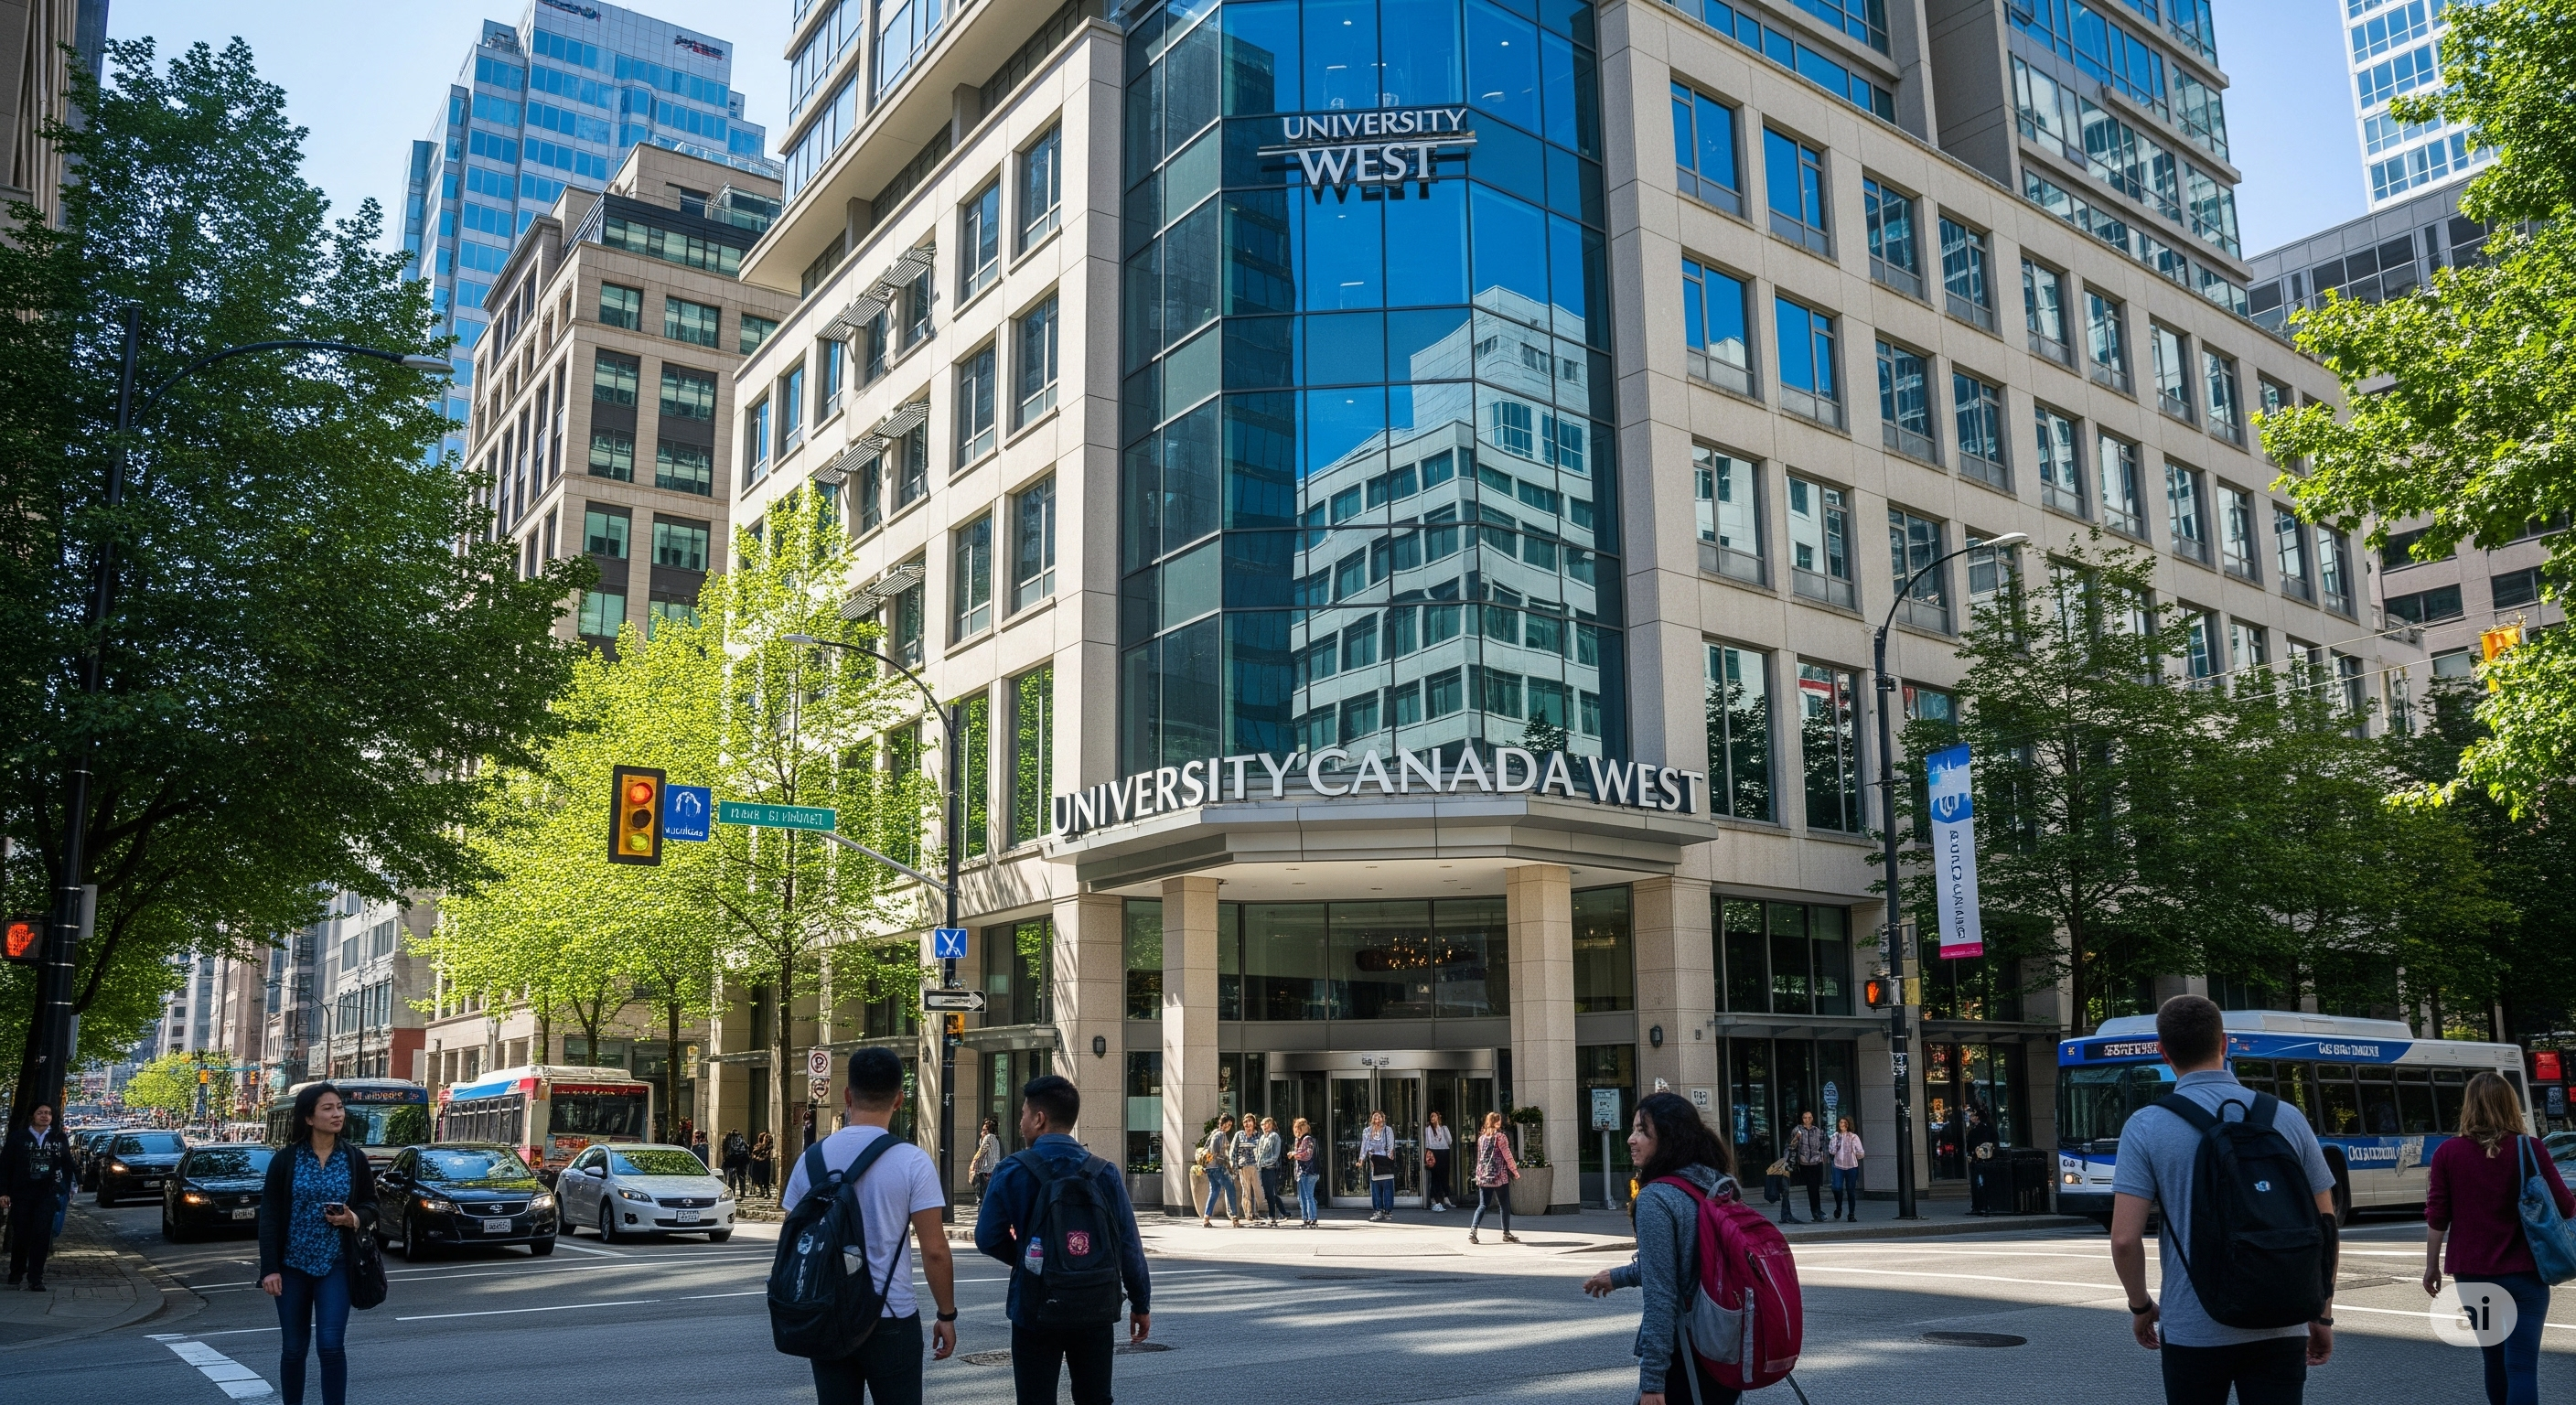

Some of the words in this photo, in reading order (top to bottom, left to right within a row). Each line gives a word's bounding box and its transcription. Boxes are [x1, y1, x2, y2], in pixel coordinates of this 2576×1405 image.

[1283, 108, 1467, 140] UNIVERSITY
[1296, 142, 1438, 186] WEST
[1052, 752, 1299, 837] UNIVERSITY
[1307, 745, 1575, 798] CANADA
[1585, 755, 1704, 815] WEST
